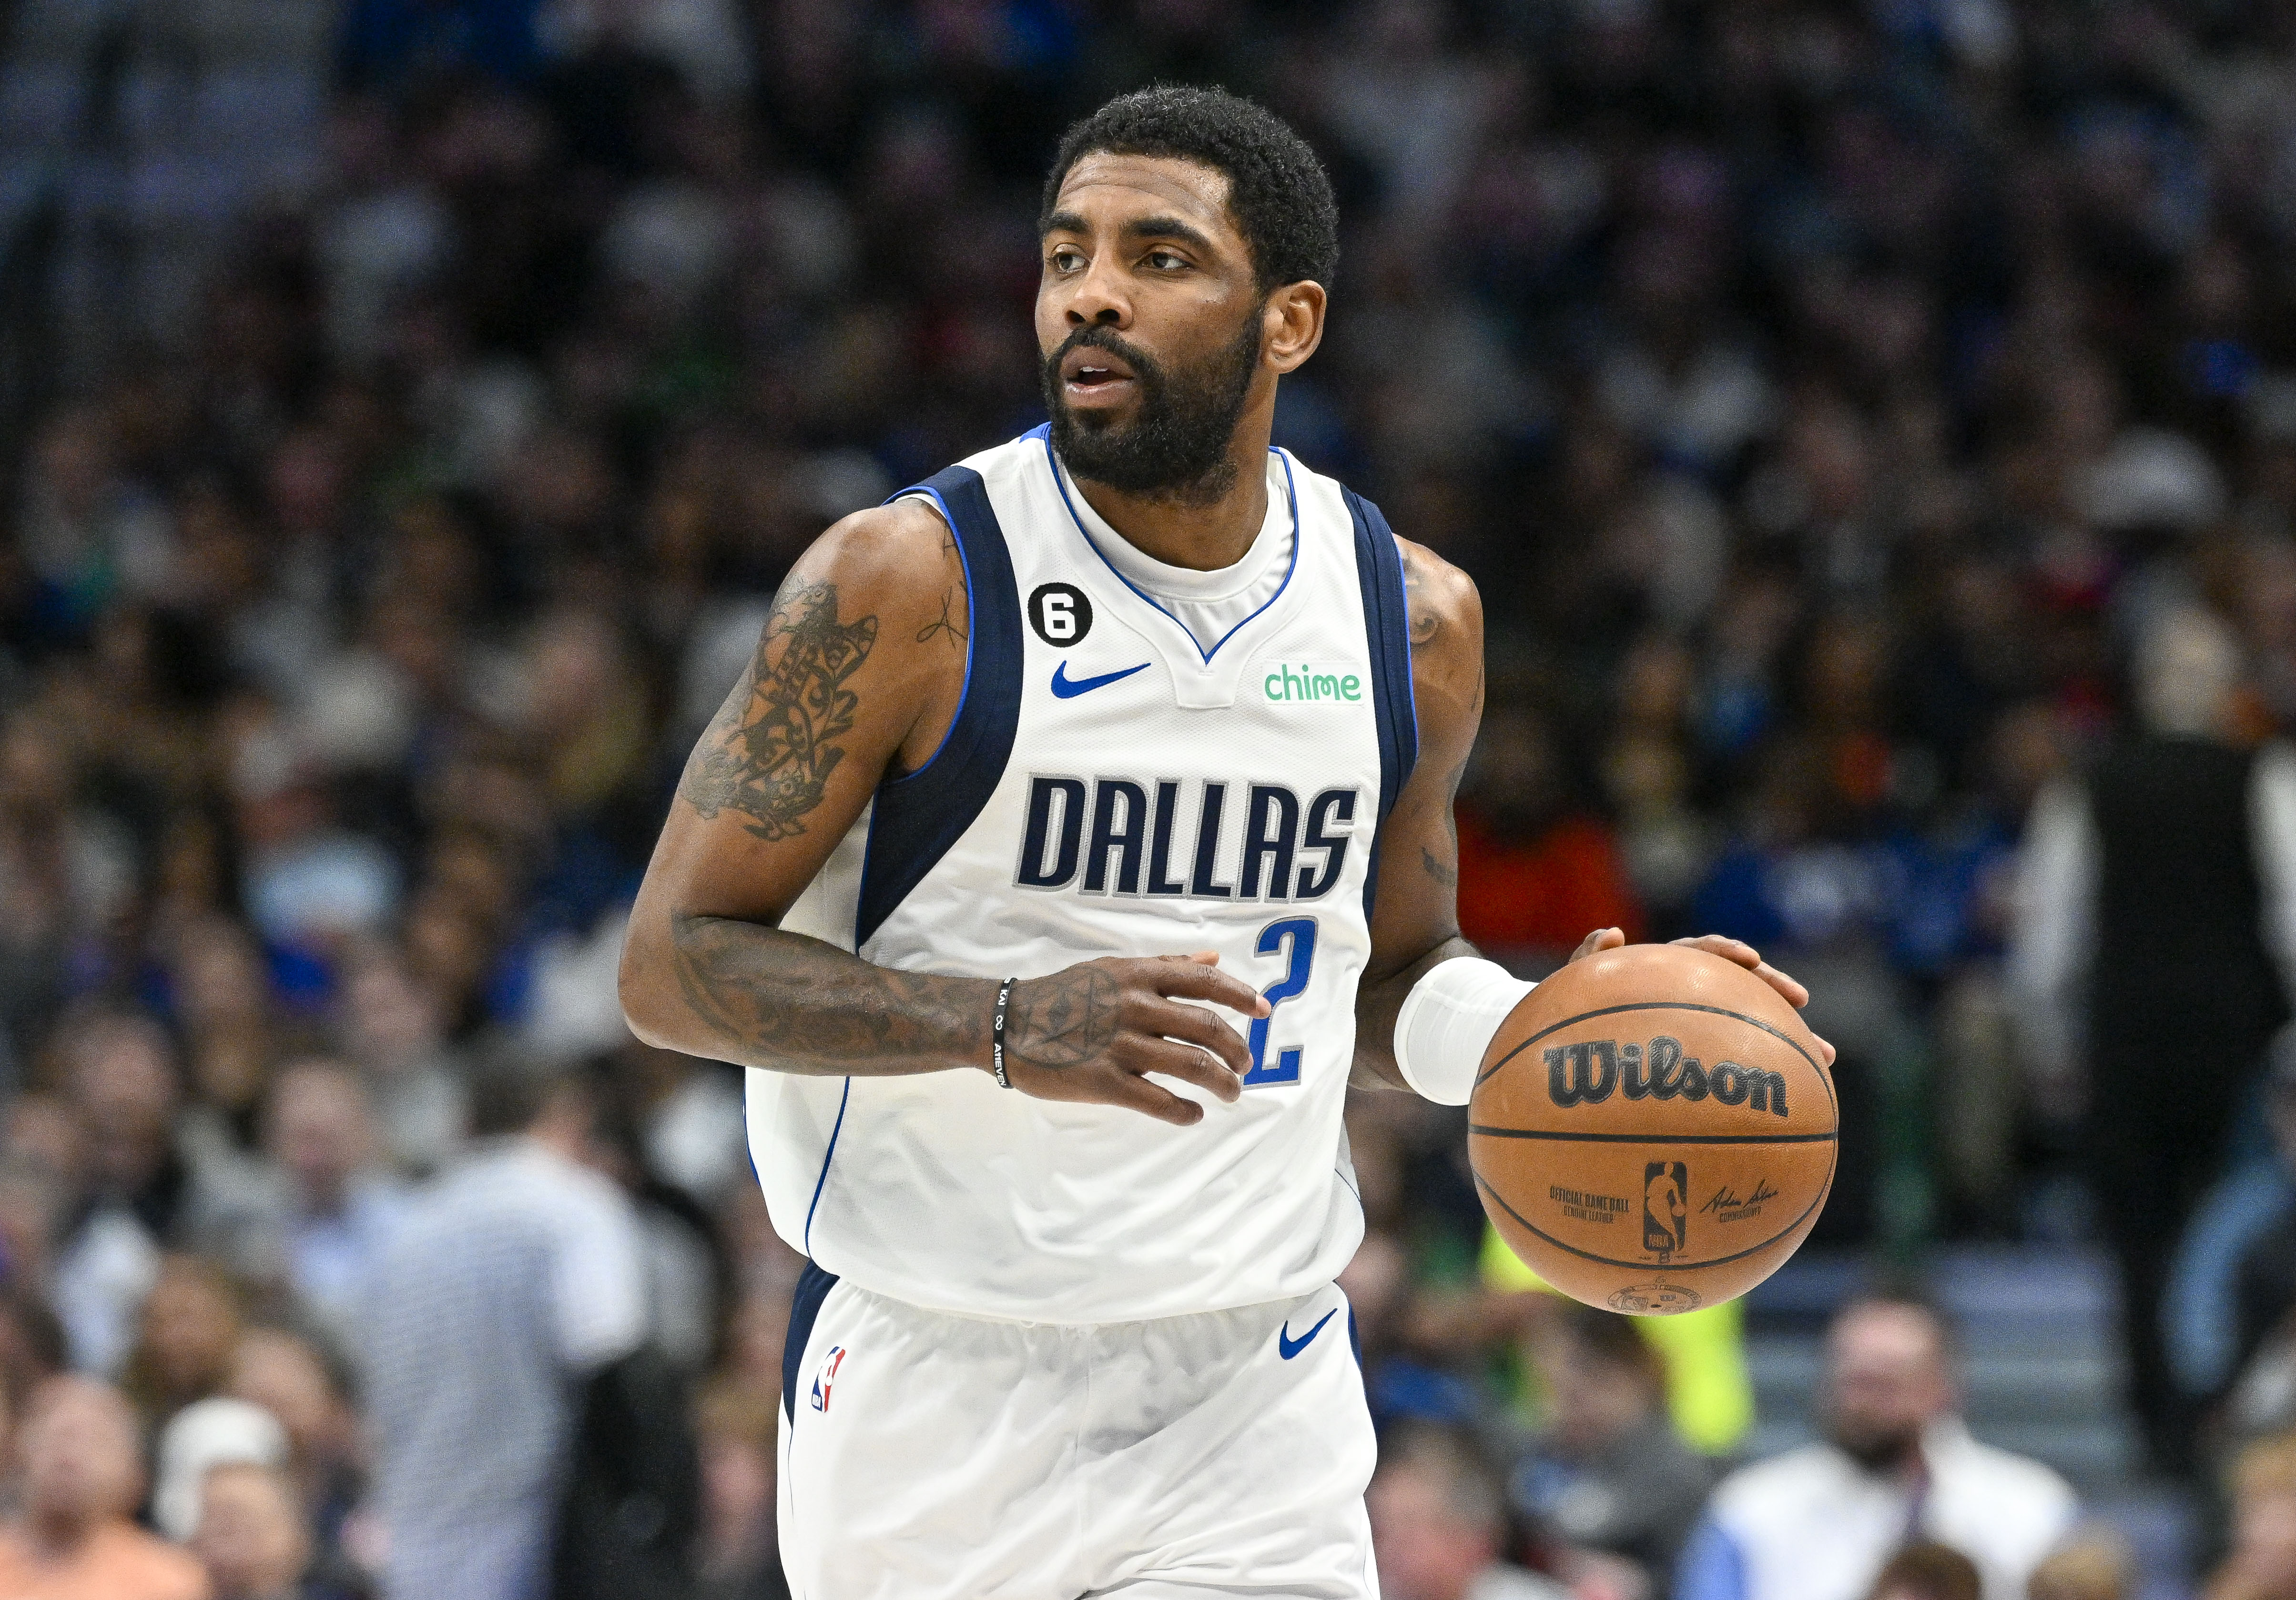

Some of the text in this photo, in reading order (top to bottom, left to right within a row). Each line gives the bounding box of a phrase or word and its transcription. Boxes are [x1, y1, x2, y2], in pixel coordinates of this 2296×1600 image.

[1041, 592, 1074, 639] 6
[1264, 664, 1361, 702] chime
[1012, 772, 1361, 904] DALLAS
[1239, 915, 1319, 1090] 2
[1543, 1036, 1788, 1118] Wilson
[1550, 1185, 1629, 1213] OFFICIAL GAME BALL
